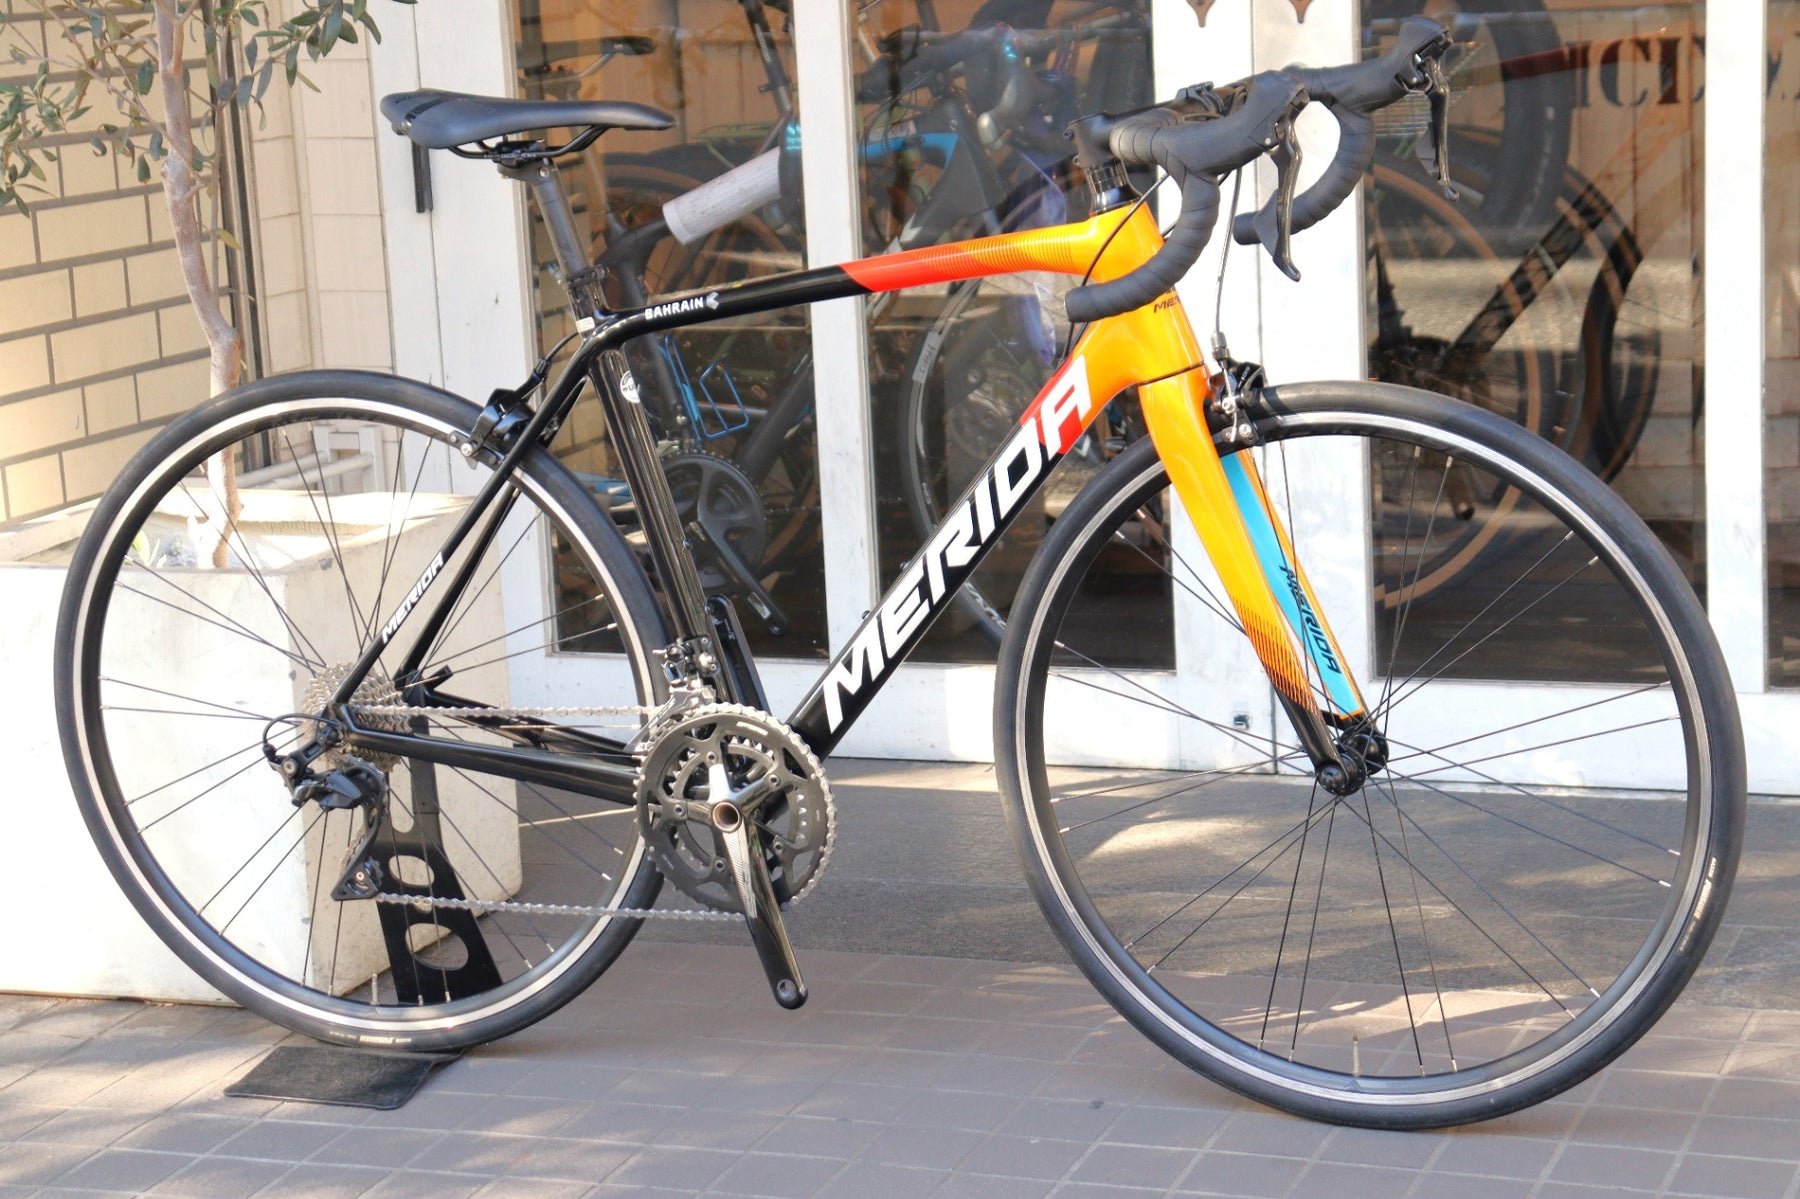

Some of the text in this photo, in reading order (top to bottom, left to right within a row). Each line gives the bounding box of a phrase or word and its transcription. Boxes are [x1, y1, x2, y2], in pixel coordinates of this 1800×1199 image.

[644, 296, 704, 320] BAHRAIN
[822, 354, 1092, 734] MERIDA
[381, 551, 444, 644] MERIDA
[1279, 564, 1342, 674] MERIDA
